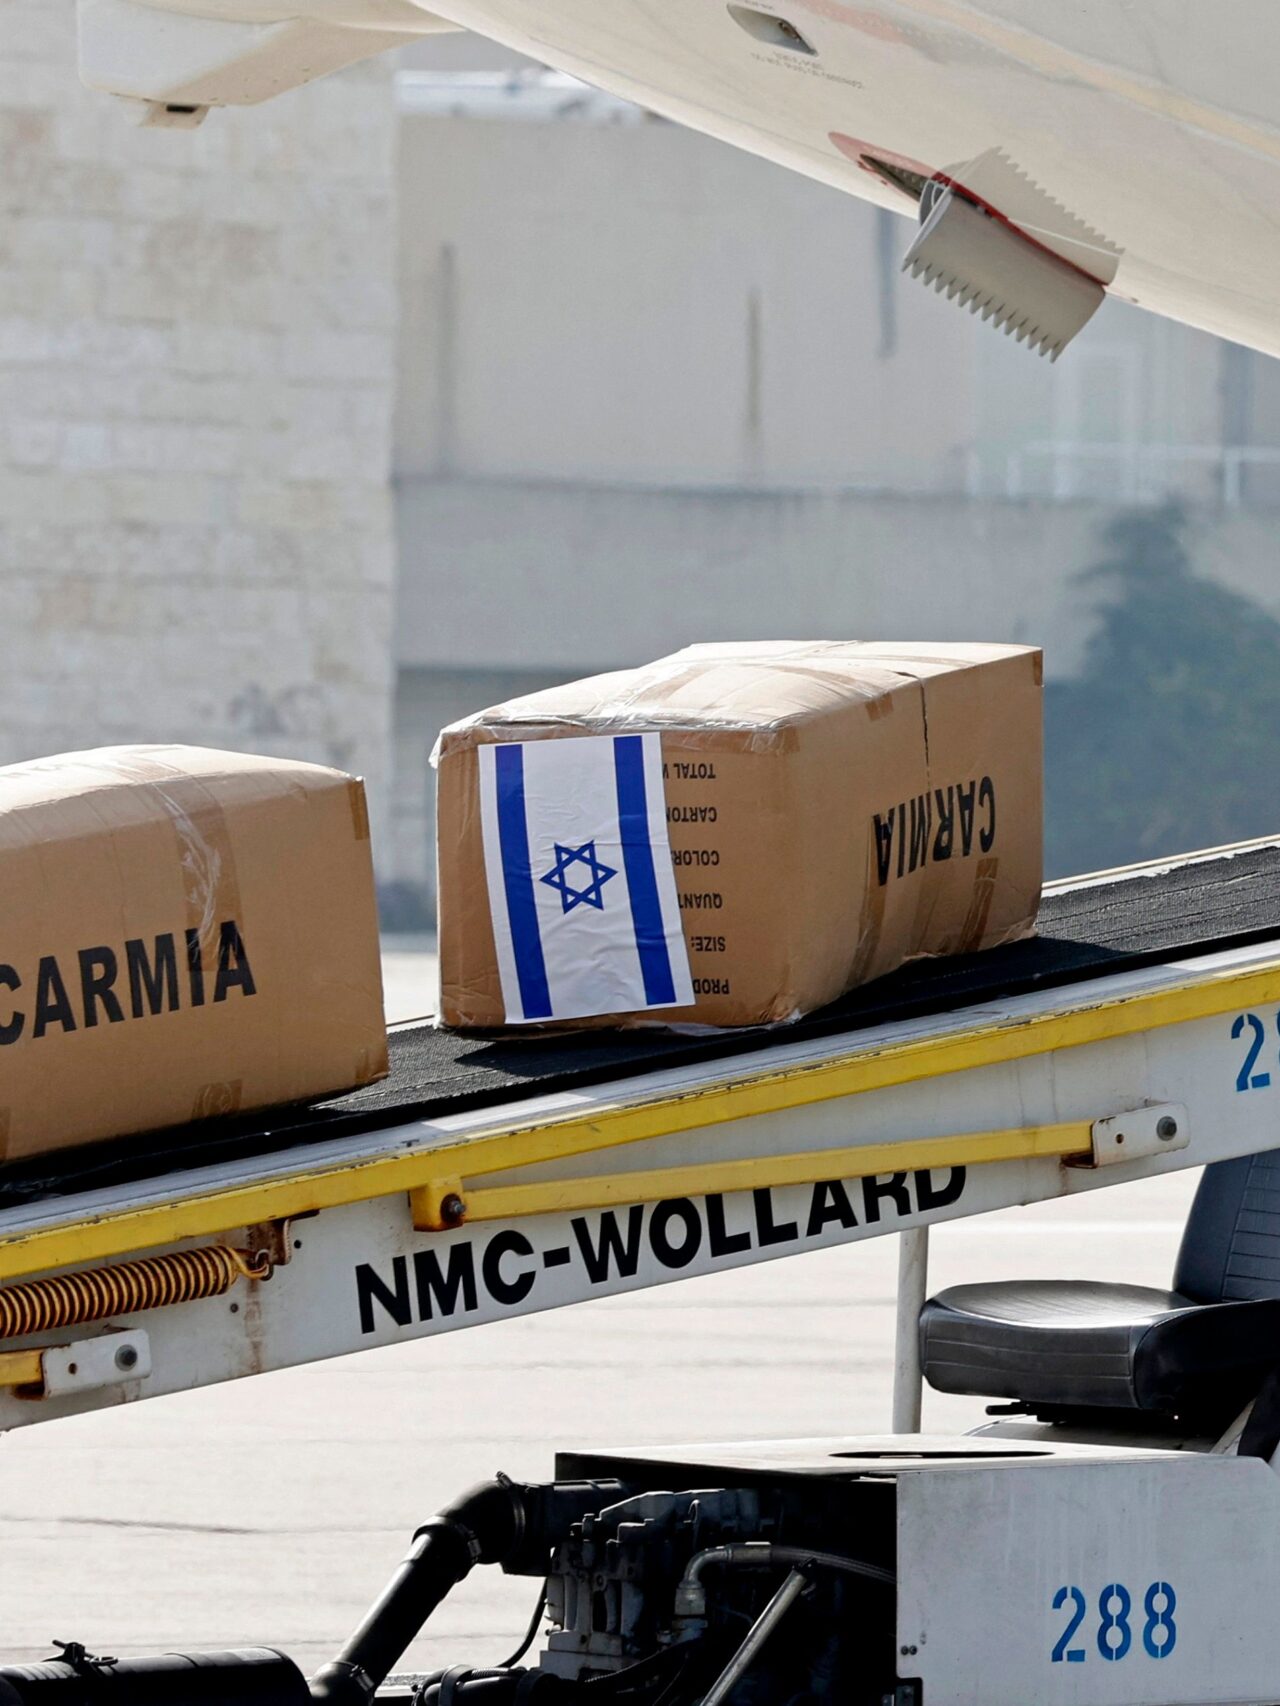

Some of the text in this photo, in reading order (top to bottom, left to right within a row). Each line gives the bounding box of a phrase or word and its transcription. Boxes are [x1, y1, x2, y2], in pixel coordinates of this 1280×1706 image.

[673, 763, 716, 779] TOTAL
[872, 775, 996, 887] CARMIA
[0, 920, 257, 1046] CARMIA
[691, 936, 726, 952] SIZE:
[354, 1165, 968, 1335] NMC-WOLLARD
[1051, 1581, 1177, 1662] 288
